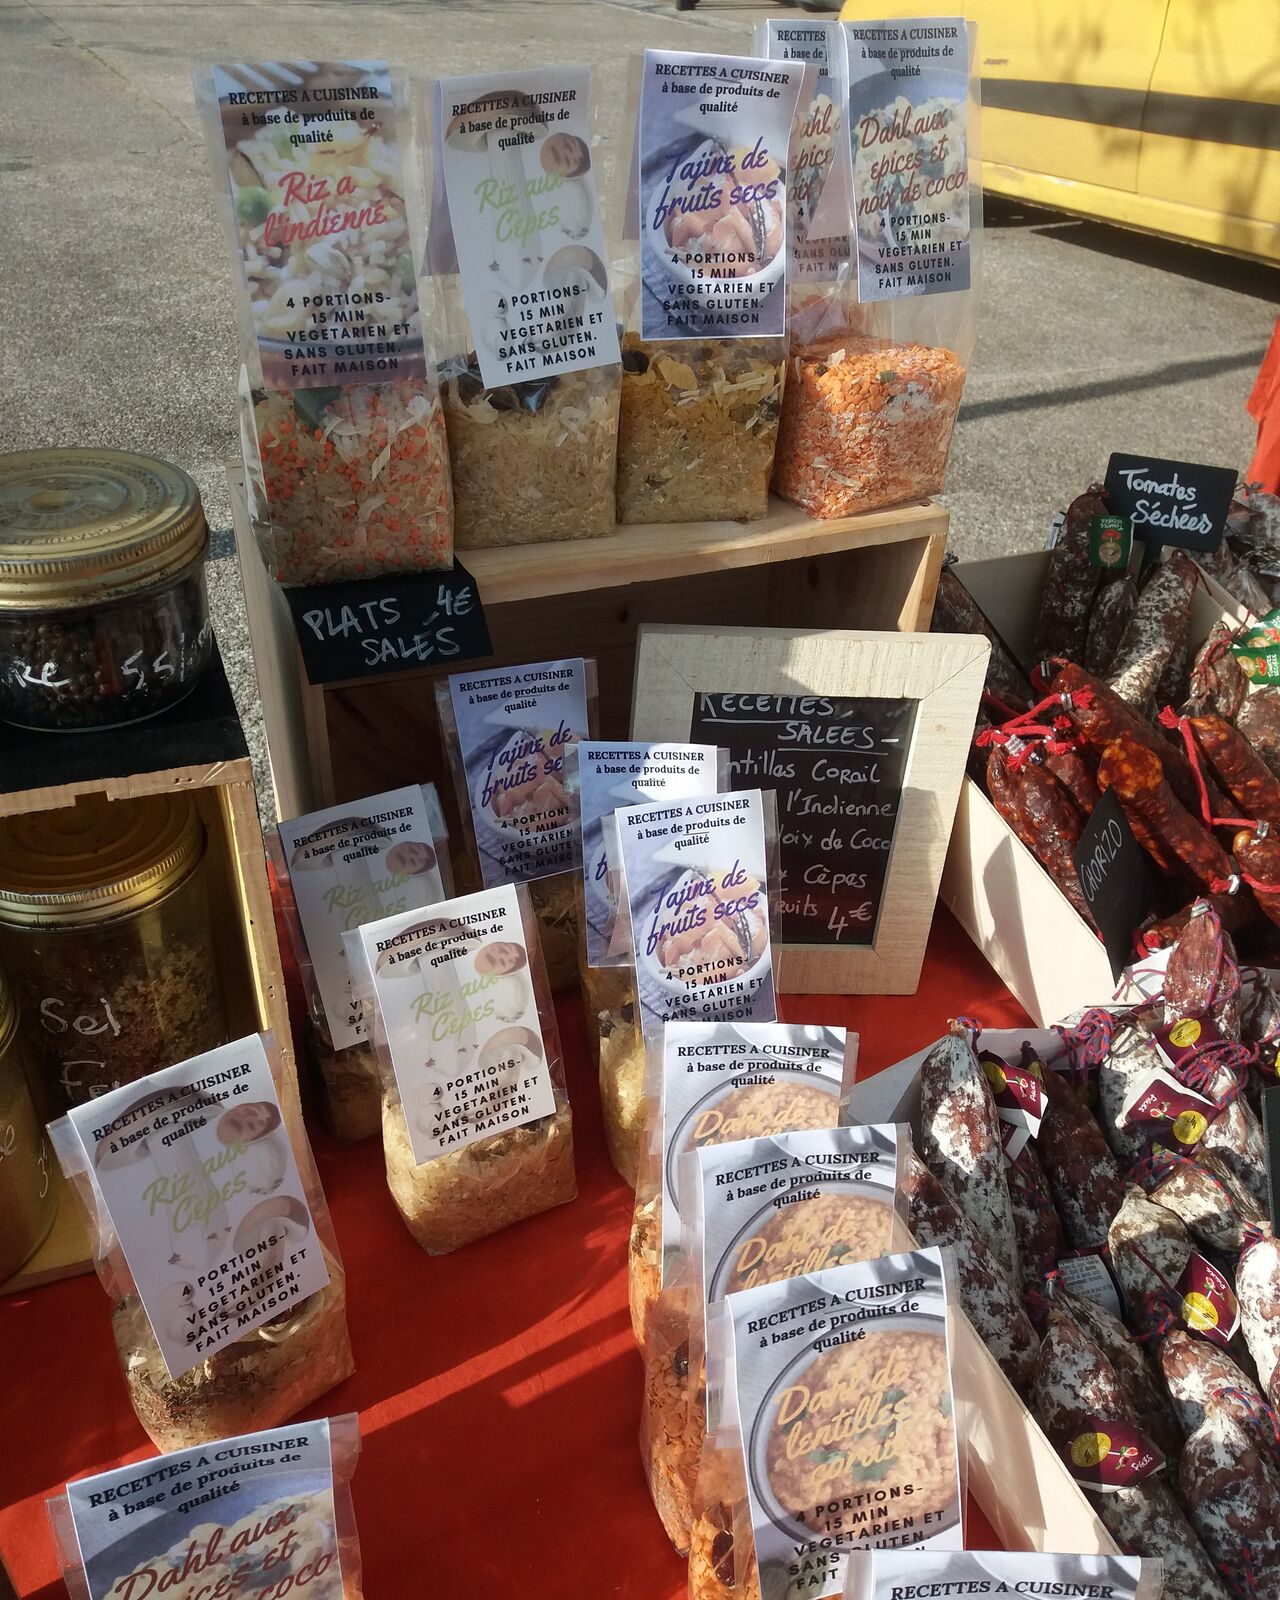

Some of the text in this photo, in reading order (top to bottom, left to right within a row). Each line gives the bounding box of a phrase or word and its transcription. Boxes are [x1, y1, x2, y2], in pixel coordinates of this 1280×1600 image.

[778, 30, 825, 41] RECETTES
[853, 29, 898, 41] RECETTES
[910, 27, 958, 40] CUISINER
[869, 48, 886, 59] base
[888, 48, 898, 59] de
[900, 46, 940, 62] produits
[942, 46, 954, 55] de
[655, 64, 716, 77] RECETTES
[731, 69, 789, 84] CUISINER
[891, 65, 921, 80] qualité
[229, 89, 298, 105] RECETTES
[313, 87, 379, 101] CUISINER
[452, 98, 509, 116] RECETTES
[522, 91, 576, 107] CUISINER
[671, 83, 697, 94] base
[700, 84, 713, 94] de
[716, 85, 764, 98] produits
[767, 88, 779, 98] de
[252, 111, 281, 124] base
[284, 111, 299, 124] de
[303, 110, 356, 127] produits
[359, 108, 375, 120] de
[468, 119, 492, 133] base
[495, 117, 508, 129] de
[510, 112, 555, 130] produits
[558, 109, 570, 121] de
[700, 102, 737, 115] qualité
[290, 130, 333, 148] qualité
[498, 133, 534, 150] qualité
[860, 105, 948, 149] Dahl aux
[666, 136, 768, 190] Tajine de
[929, 135, 949, 161] et
[279, 171, 354, 207] Riz a
[474, 178, 518, 213] Riz
[653, 179, 779, 230] fruits secs
[858, 170, 967, 217] noix de coco
[303, 292, 391, 307] PORTIONS-
[311, 310, 364, 323] 15 MIN
[287, 324, 410, 342] VEGETARIEN ET
[284, 346, 325, 359] SANS
[292, 359, 398, 376] FAIT MAISON
[1119, 468, 1197, 501] Tomates
[1130, 500, 1213, 534] Séchées
[303, 598, 400, 641] PLATS
[459, 676, 512, 692] RECETTES
[523, 669, 574, 682] CUISINER
[488, 720, 573, 771] Tajine de
[588, 752, 641, 760] RECETTES
[653, 752, 704, 761] CUISINER
[482, 761, 537, 808] fruits
[293, 823, 349, 848] RECETTES
[361, 807, 414, 827] CUISINER
[627, 808, 683, 826] RECETTES
[695, 799, 750, 815] CUISINER
[820, 829, 843, 850] de
[653, 859, 747, 914] Tajine de
[376, 925, 436, 952] RECETTES
[449, 907, 507, 929] CUISINER
[646, 892, 759, 955] fruits secs
[397, 947, 422, 961] base
[425, 941, 438, 951] de
[440, 930, 488, 950] produits
[490, 923, 503, 933] de
[431, 946, 468, 967] qualité
[40, 997, 121, 1037] Sel
[410, 991, 450, 1023] Riz
[677, 1044, 746, 1056] RECETTES
[763, 1045, 830, 1058] CUISINER
[92, 1063, 251, 1142] RECETTES A CUISINER
[715, 1159, 788, 1186] RECETTES
[805, 1152, 880, 1165] CUISINER
[142, 1175, 192, 1216] Riz
[747, 1298, 826, 1334] RECETTES
[845, 1278, 926, 1303] CUISINER
[775, 1345, 908, 1426] Dahl de
[786, 1396, 912, 1461] lentilles
[88, 1437, 309, 1508] RECETTES A CUISINER
[811, 1430, 900, 1485] corail
[816, 1484, 924, 1516] PORTIONS-
[824, 1506, 888, 1531] 15 MIN
[115, 1504, 299, 1600] Dahl aux
[186, 1530, 298, 1600] ices et
[891, 1580, 1114, 1600] RECETTES A CUISINER
